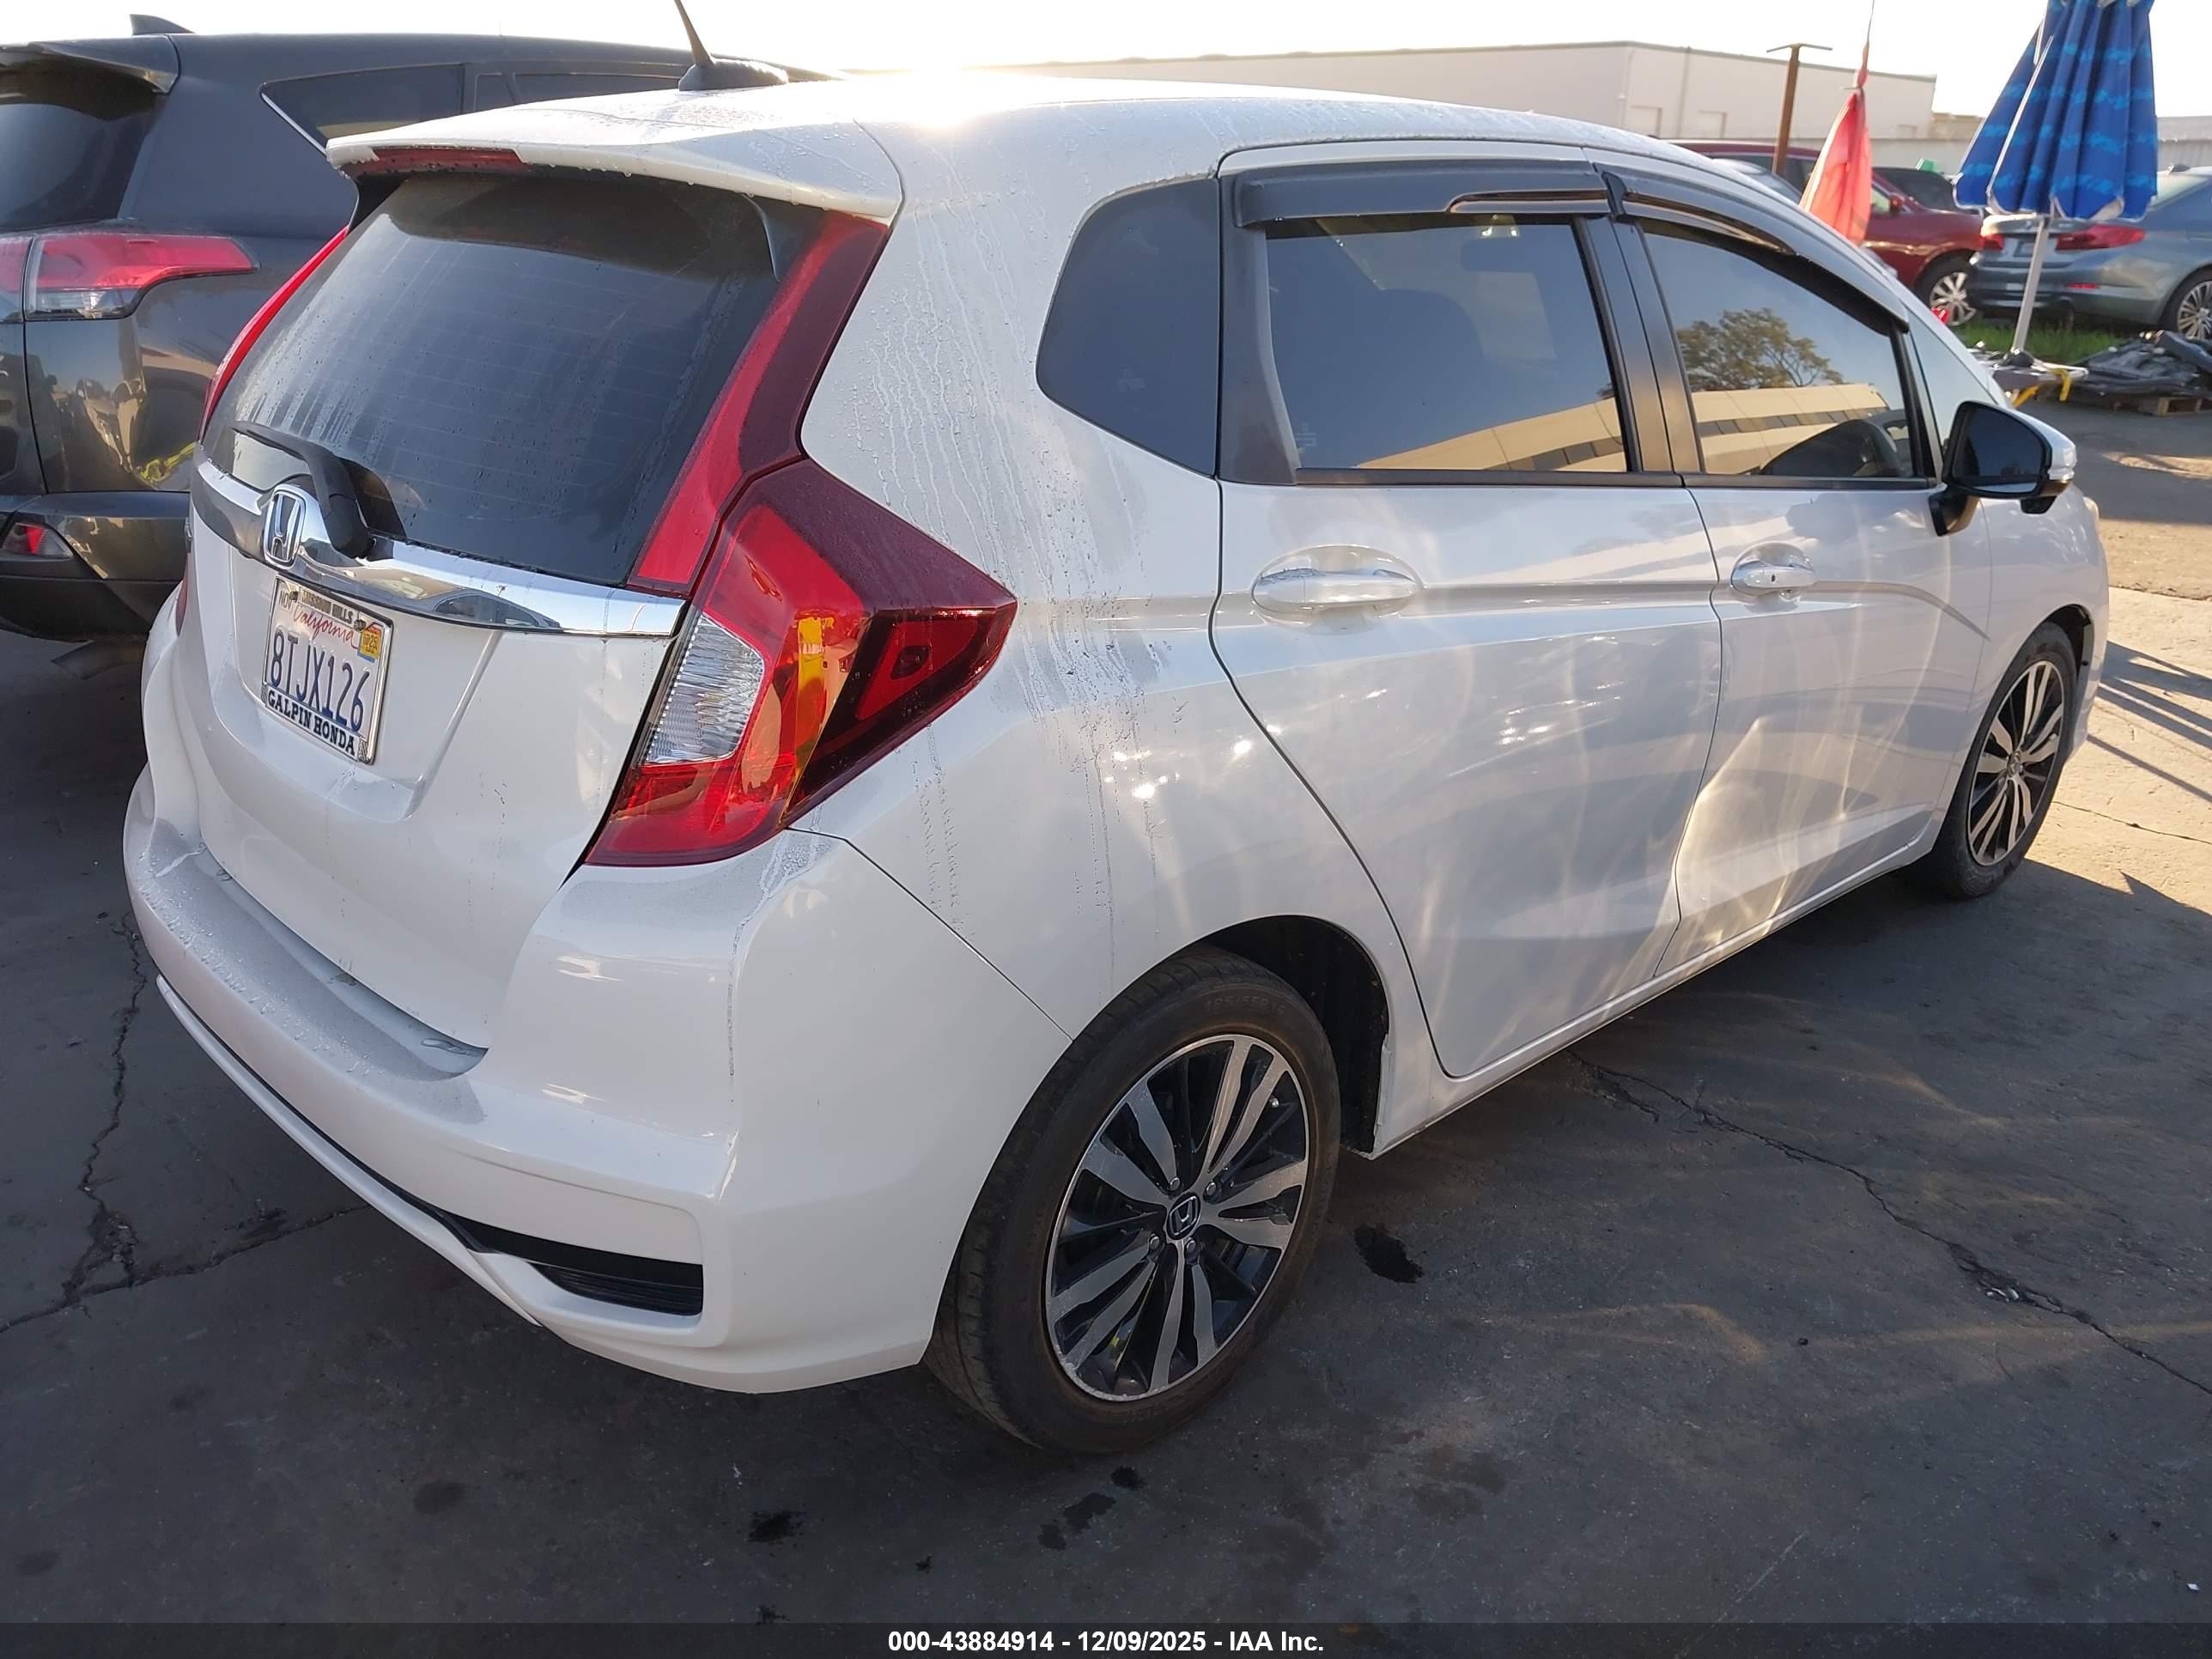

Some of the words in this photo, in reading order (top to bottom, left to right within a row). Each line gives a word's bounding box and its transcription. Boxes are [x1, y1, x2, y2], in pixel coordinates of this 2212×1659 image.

[293, 605, 359, 649] California
[270, 630, 370, 732] 8TJX126
[268, 690, 312, 729] GALPIN
[313, 715, 356, 757] HONDA
